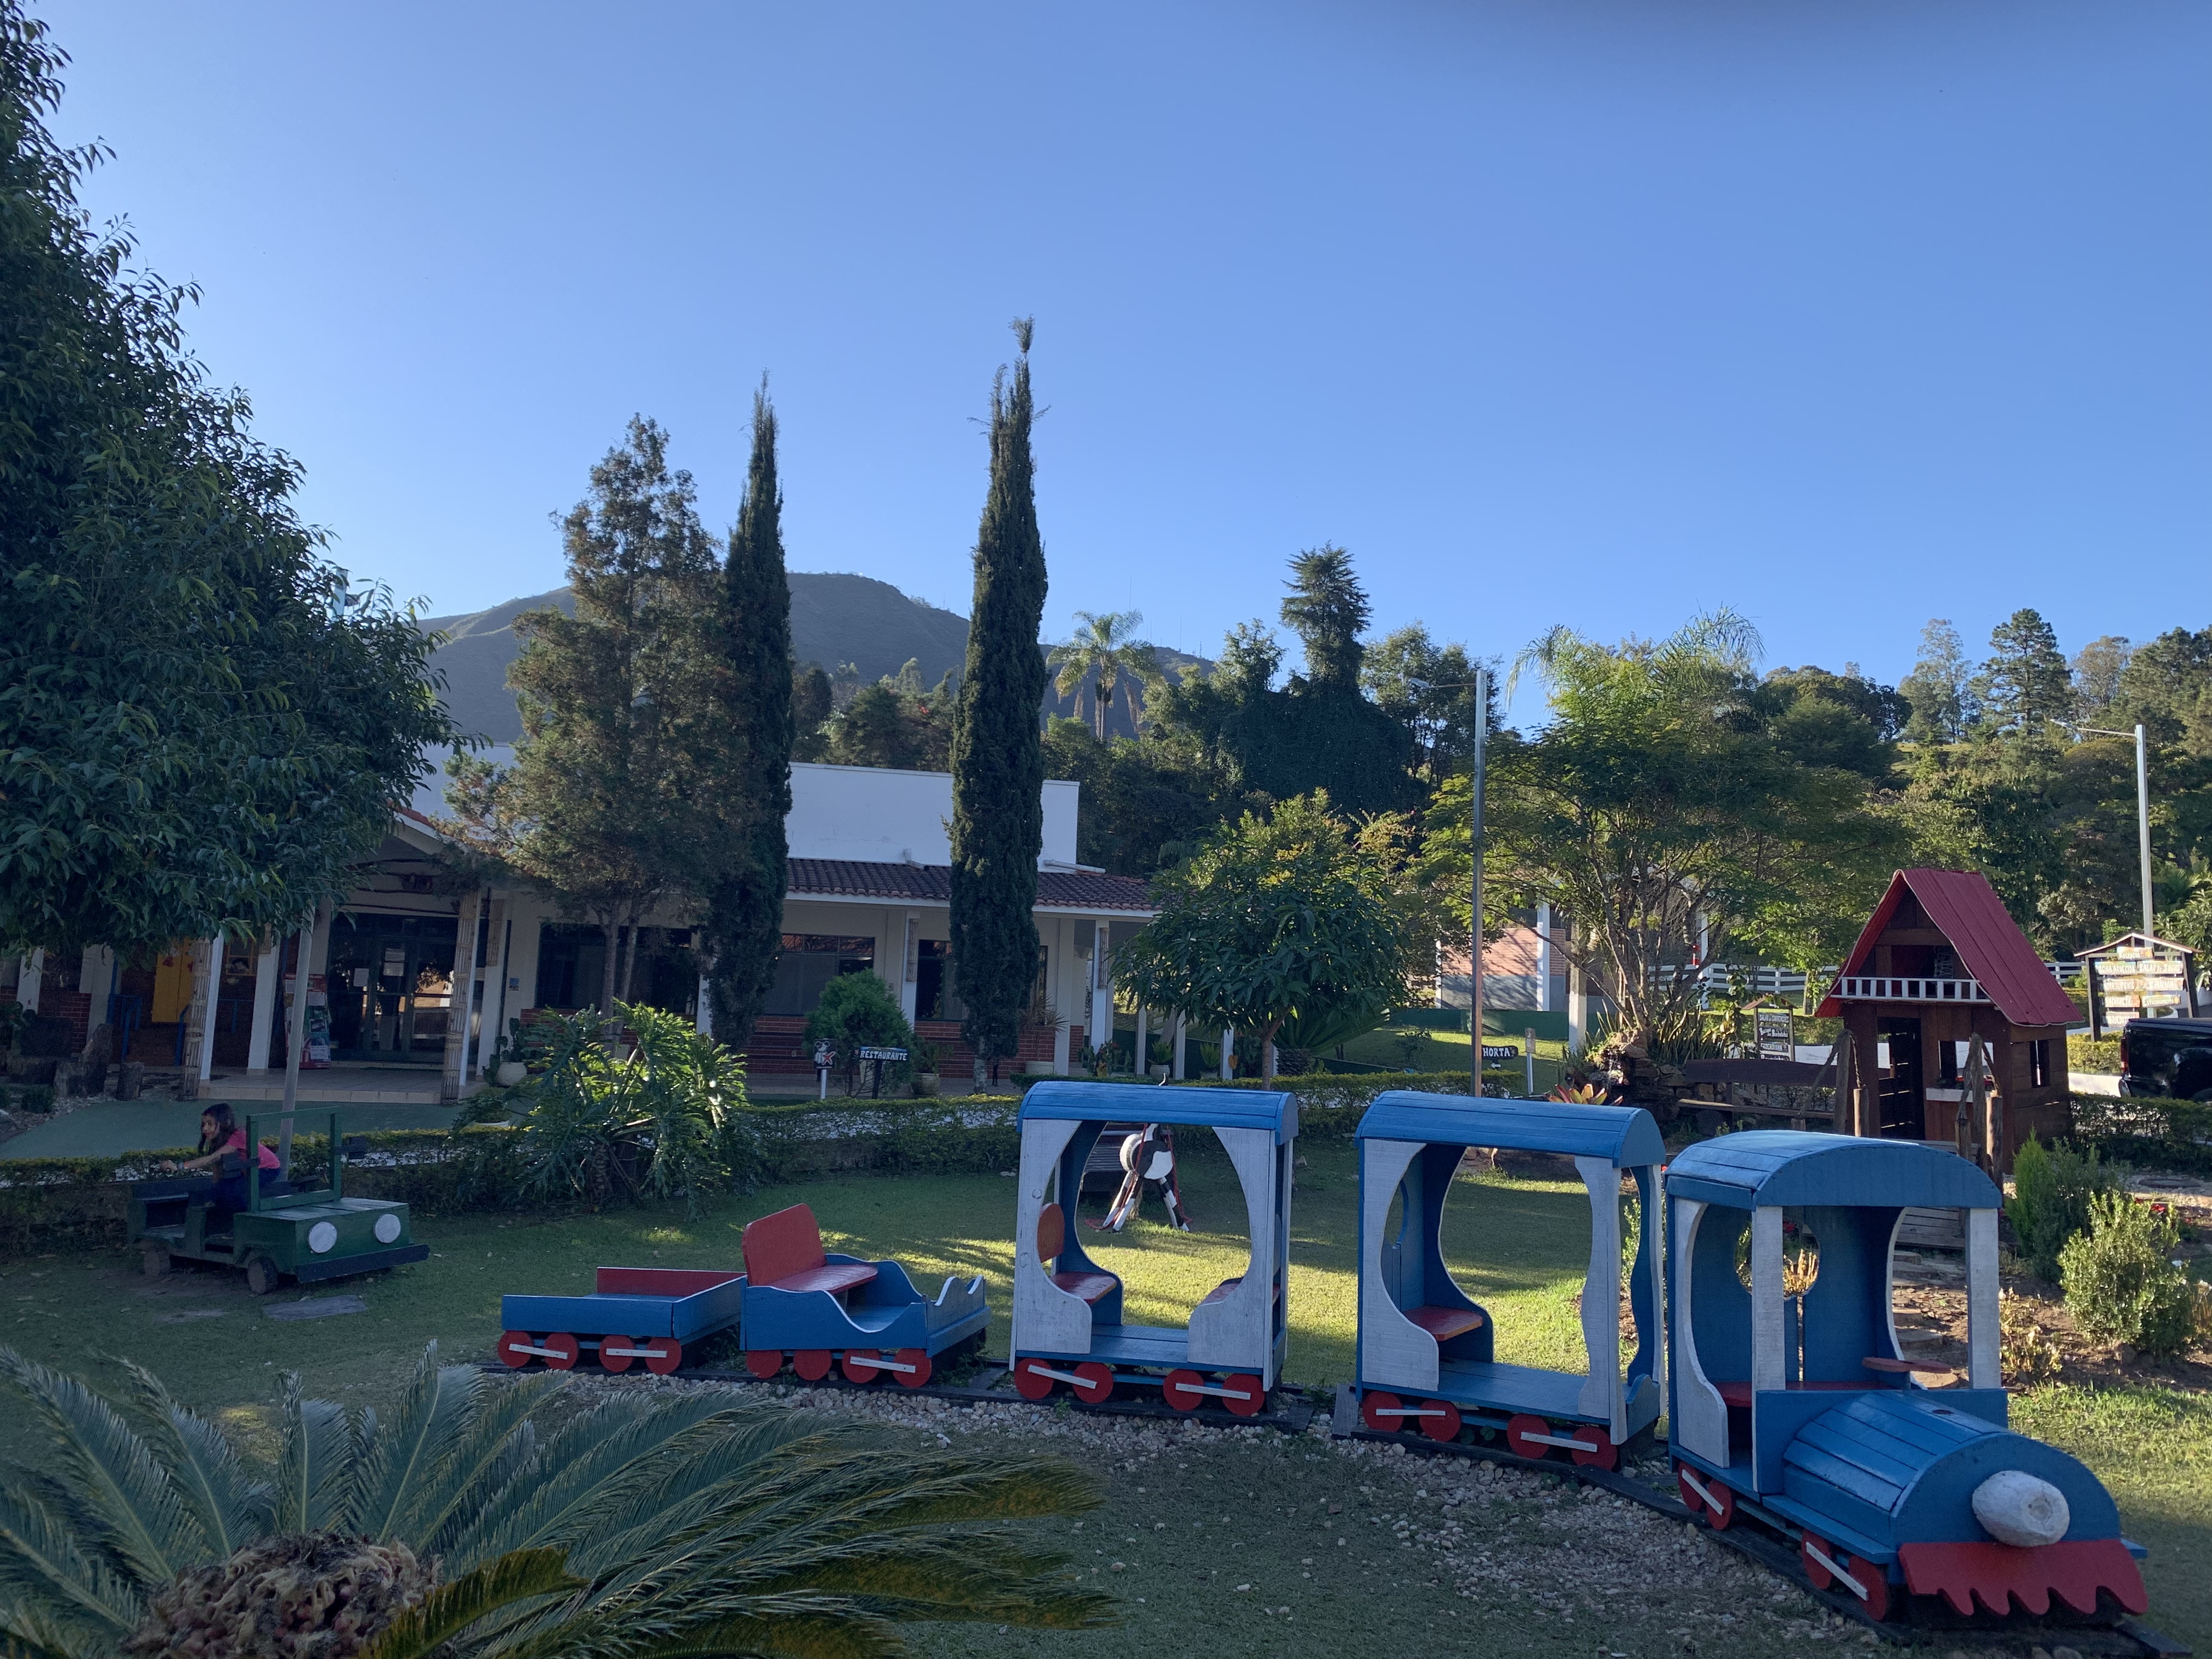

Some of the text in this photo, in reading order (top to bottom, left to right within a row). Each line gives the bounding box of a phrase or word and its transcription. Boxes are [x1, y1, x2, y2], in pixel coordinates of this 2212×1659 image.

[2113, 965, 2136, 973] AQUECIDA
[2163, 963, 2181, 972] JOGOS
[2148, 980, 2174, 989] SAUNA
[2143, 997, 2174, 1006] Estacionamento
[859, 1050, 908, 1062] RESTAURANTE
[1483, 1047, 1511, 1057] HORTA
